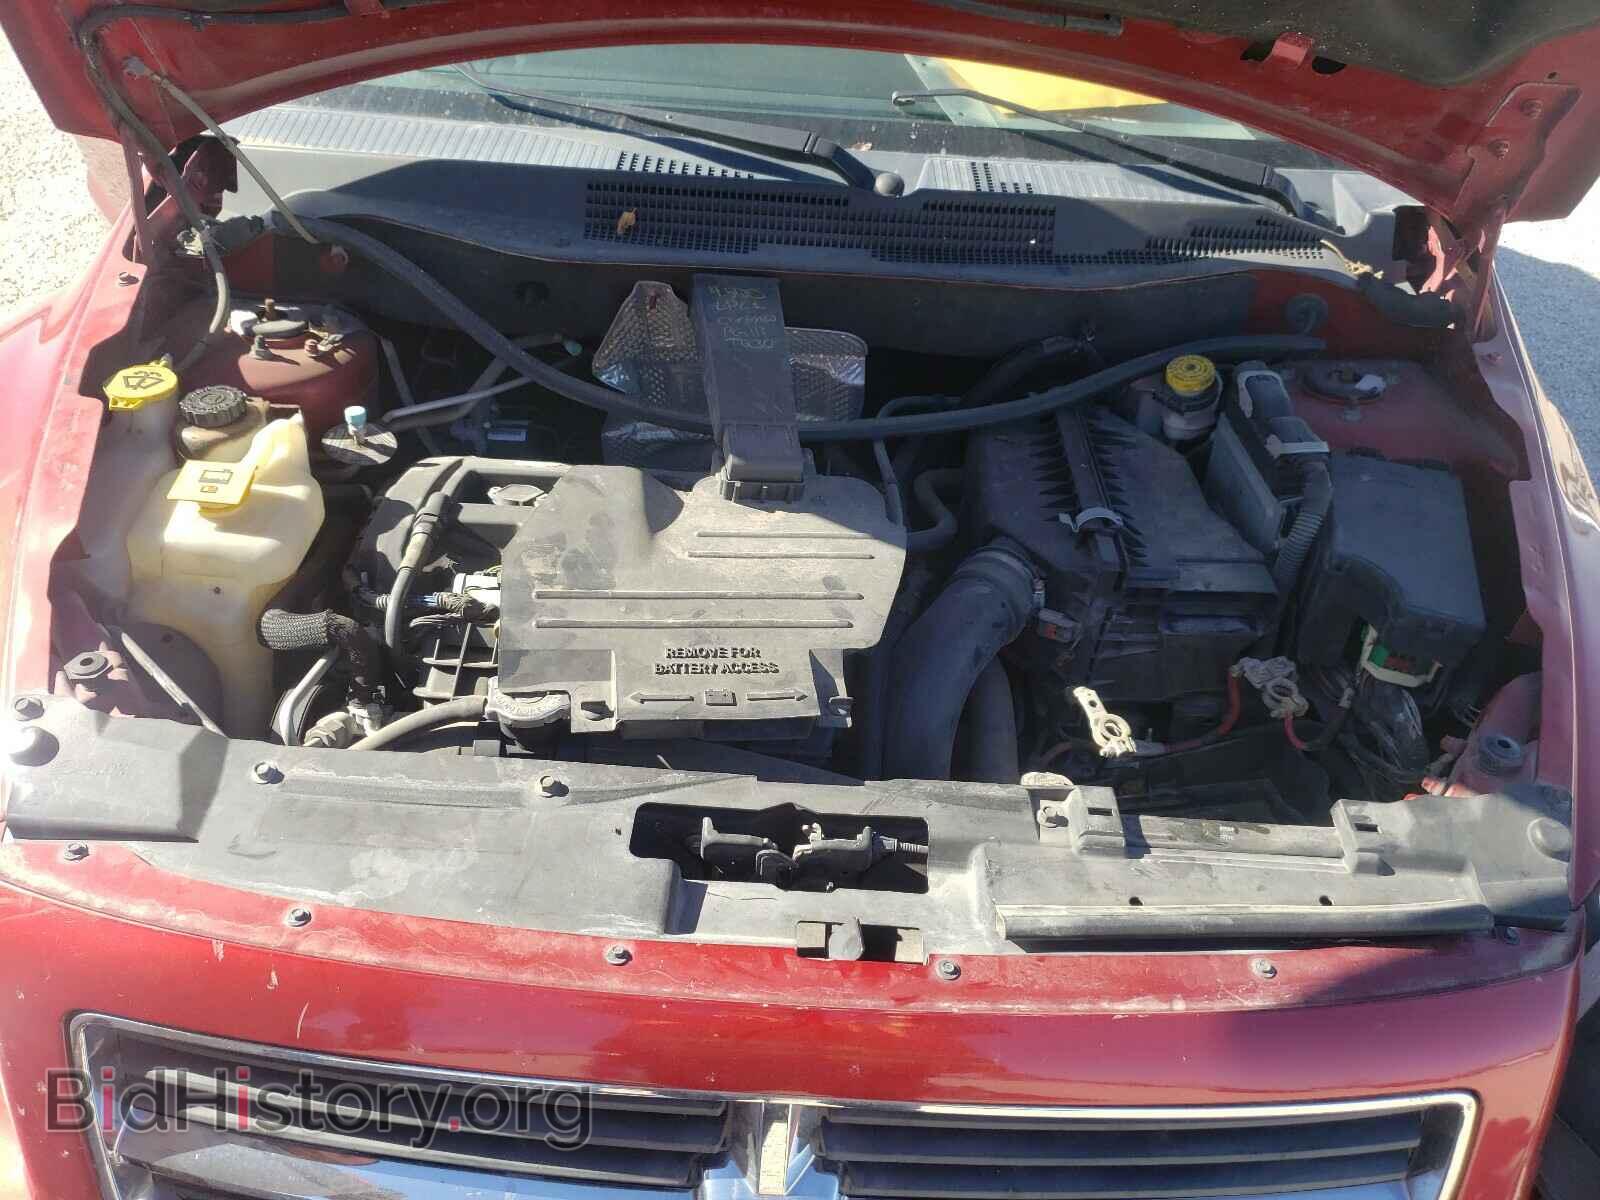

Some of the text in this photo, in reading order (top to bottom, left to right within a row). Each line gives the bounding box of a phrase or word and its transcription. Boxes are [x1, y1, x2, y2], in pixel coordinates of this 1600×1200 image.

[665, 647, 762, 659] REMOVE FOR
[655, 662, 780, 675] BATTERY ACCESS
